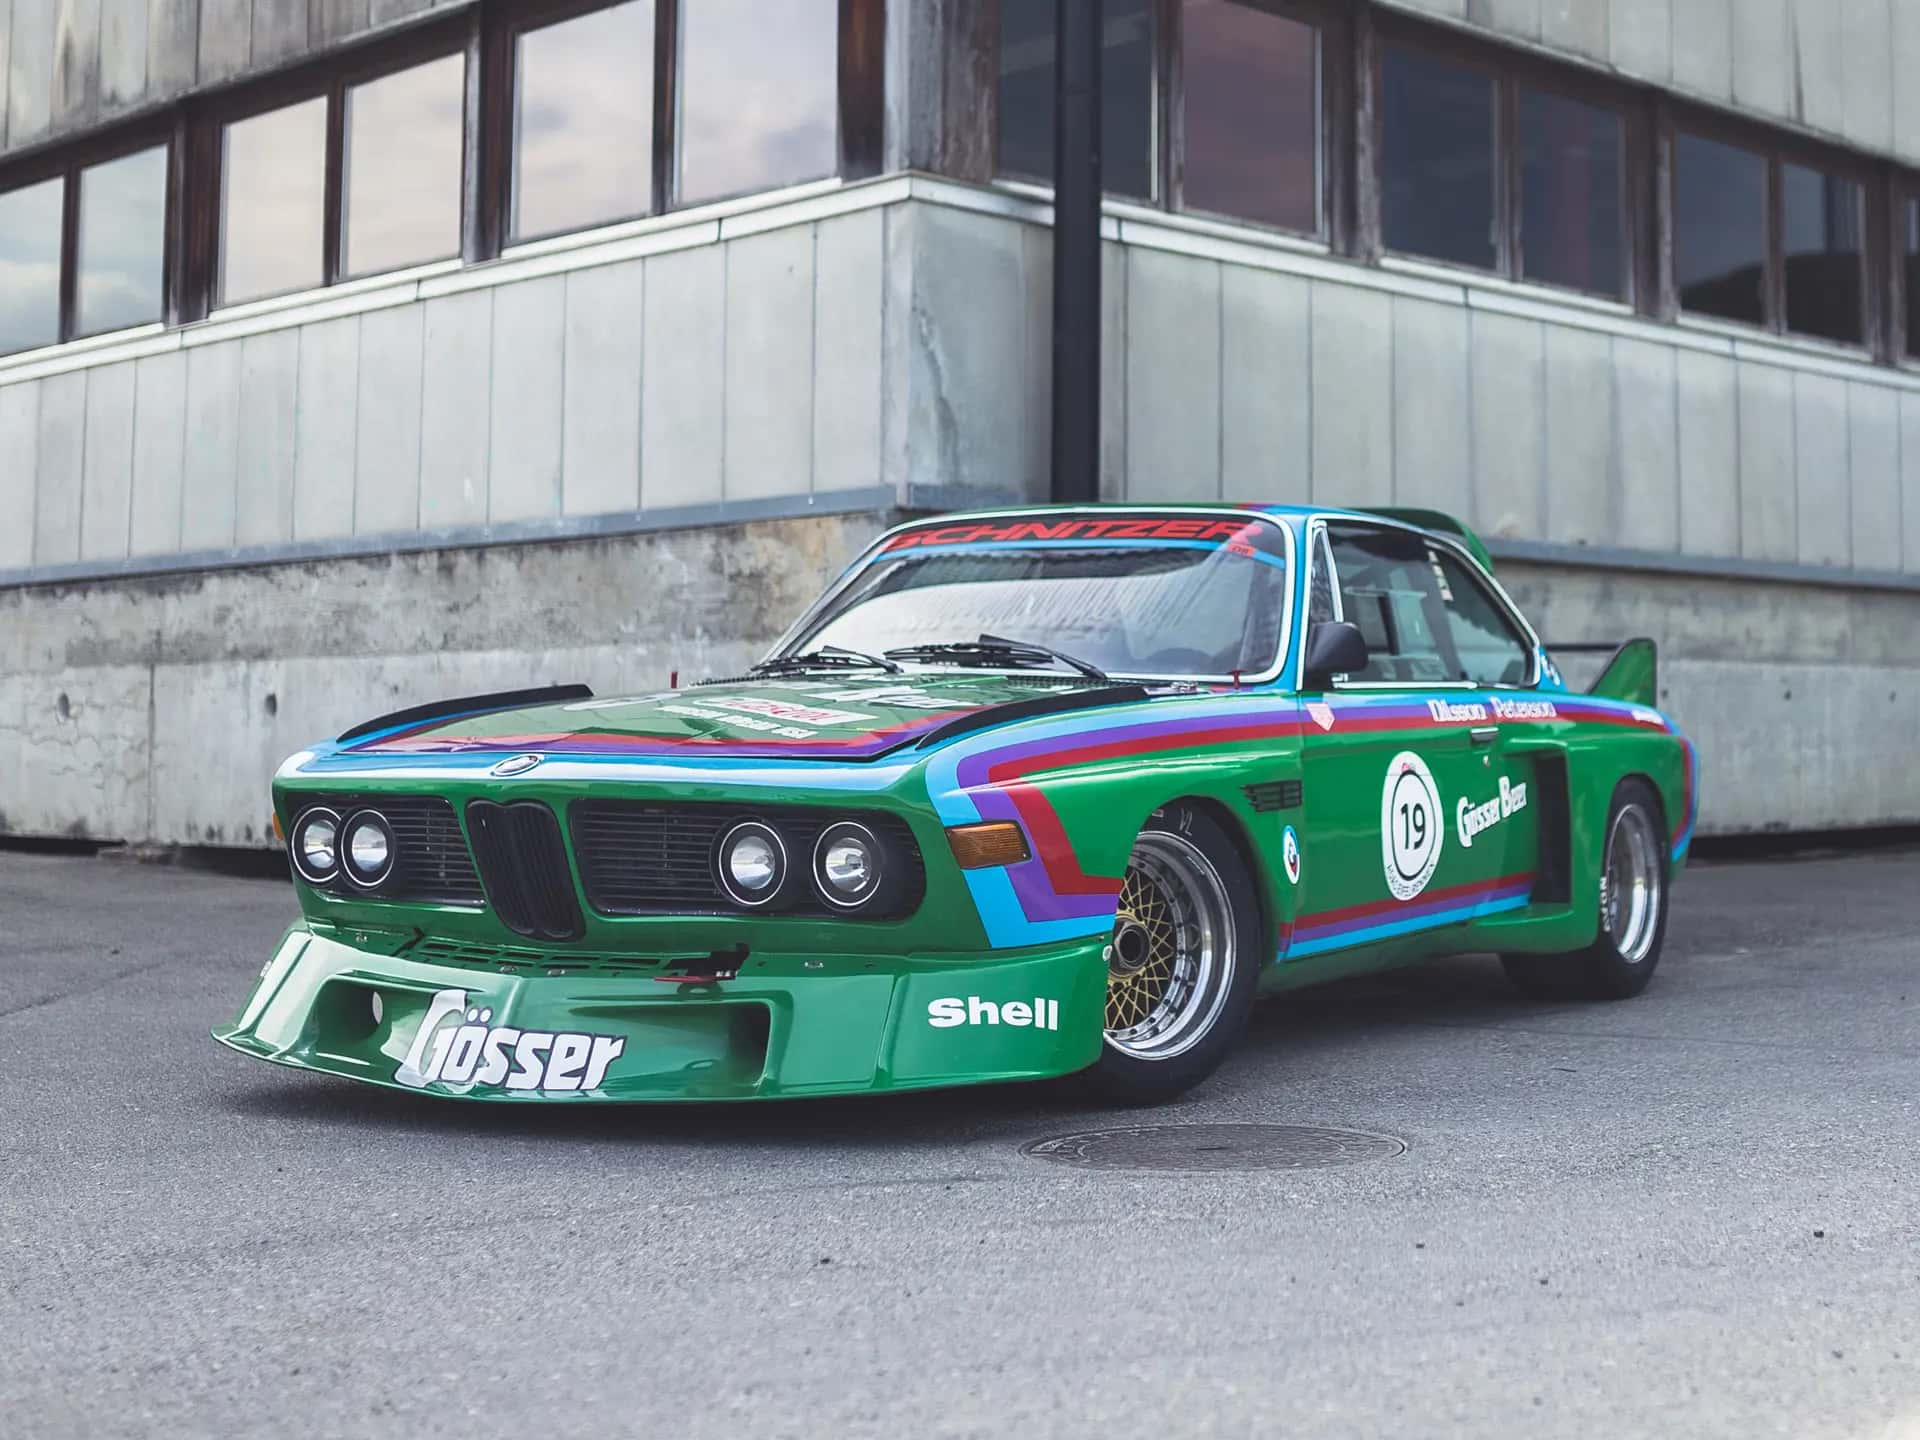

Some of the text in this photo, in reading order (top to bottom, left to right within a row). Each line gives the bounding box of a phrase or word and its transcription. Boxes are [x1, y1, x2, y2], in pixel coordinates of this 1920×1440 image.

[883, 519, 1263, 551] SCHNITZER
[1401, 803, 1425, 850] 19
[928, 996, 1058, 1031] Shell
[394, 989, 626, 1091] Gösser
